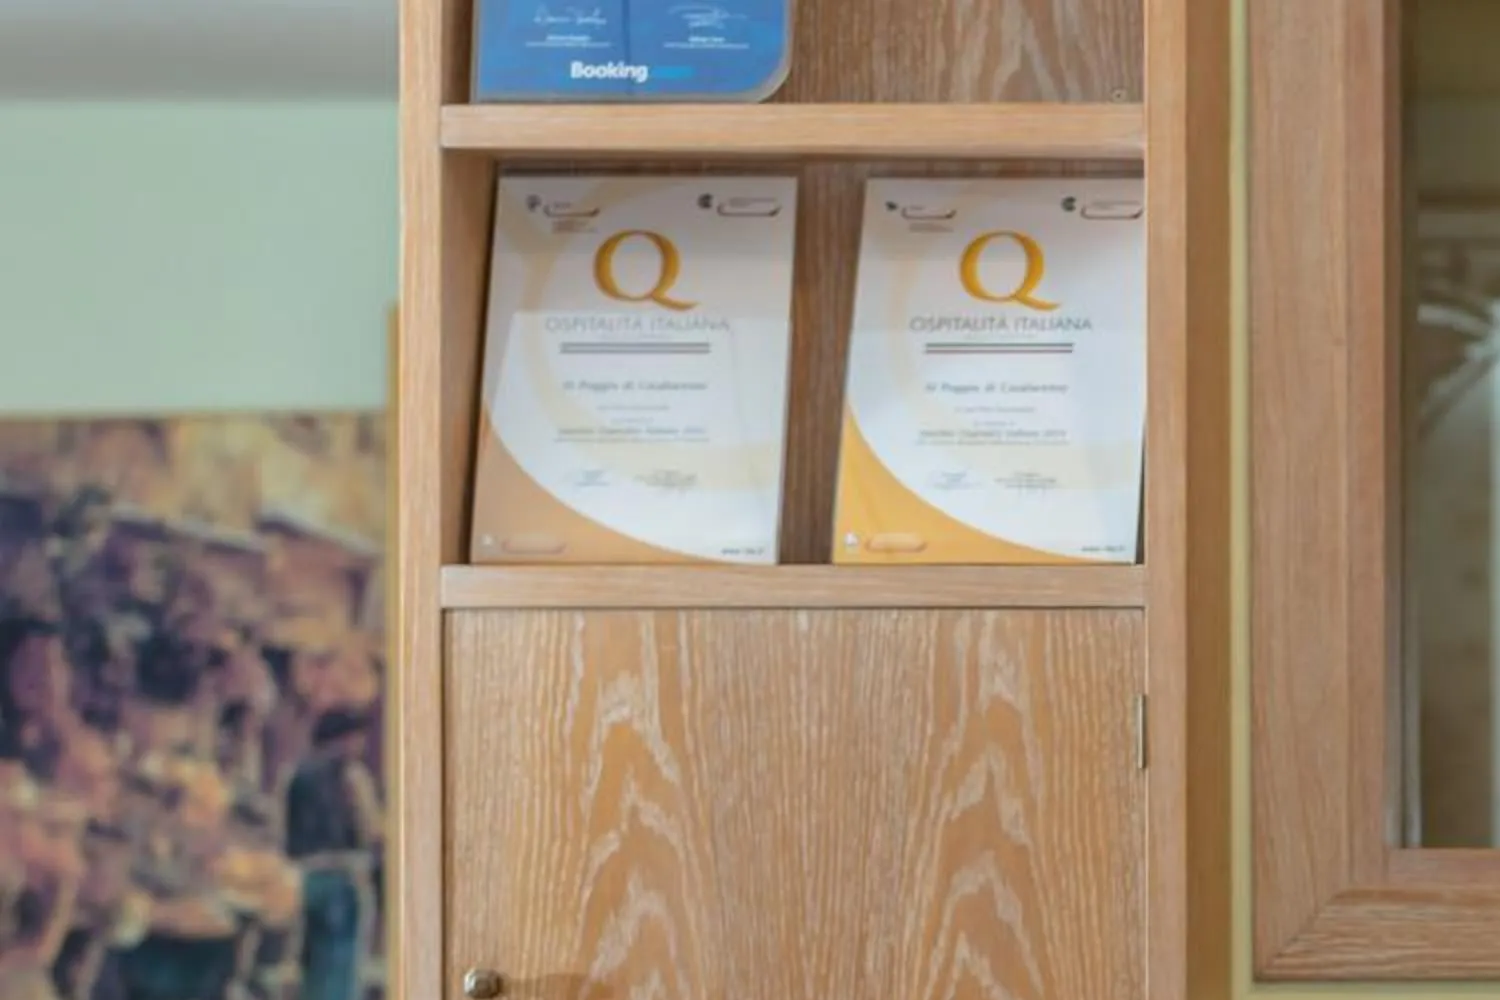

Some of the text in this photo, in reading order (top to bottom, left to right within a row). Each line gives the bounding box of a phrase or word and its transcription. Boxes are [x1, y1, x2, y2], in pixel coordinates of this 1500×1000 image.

[570, 60, 649, 83] Booking
[593, 229, 698, 312] Q
[959, 229, 1061, 312] Q
[650, 315, 731, 331] ITALIANA
[1014, 316, 1092, 331] ITALIANA
